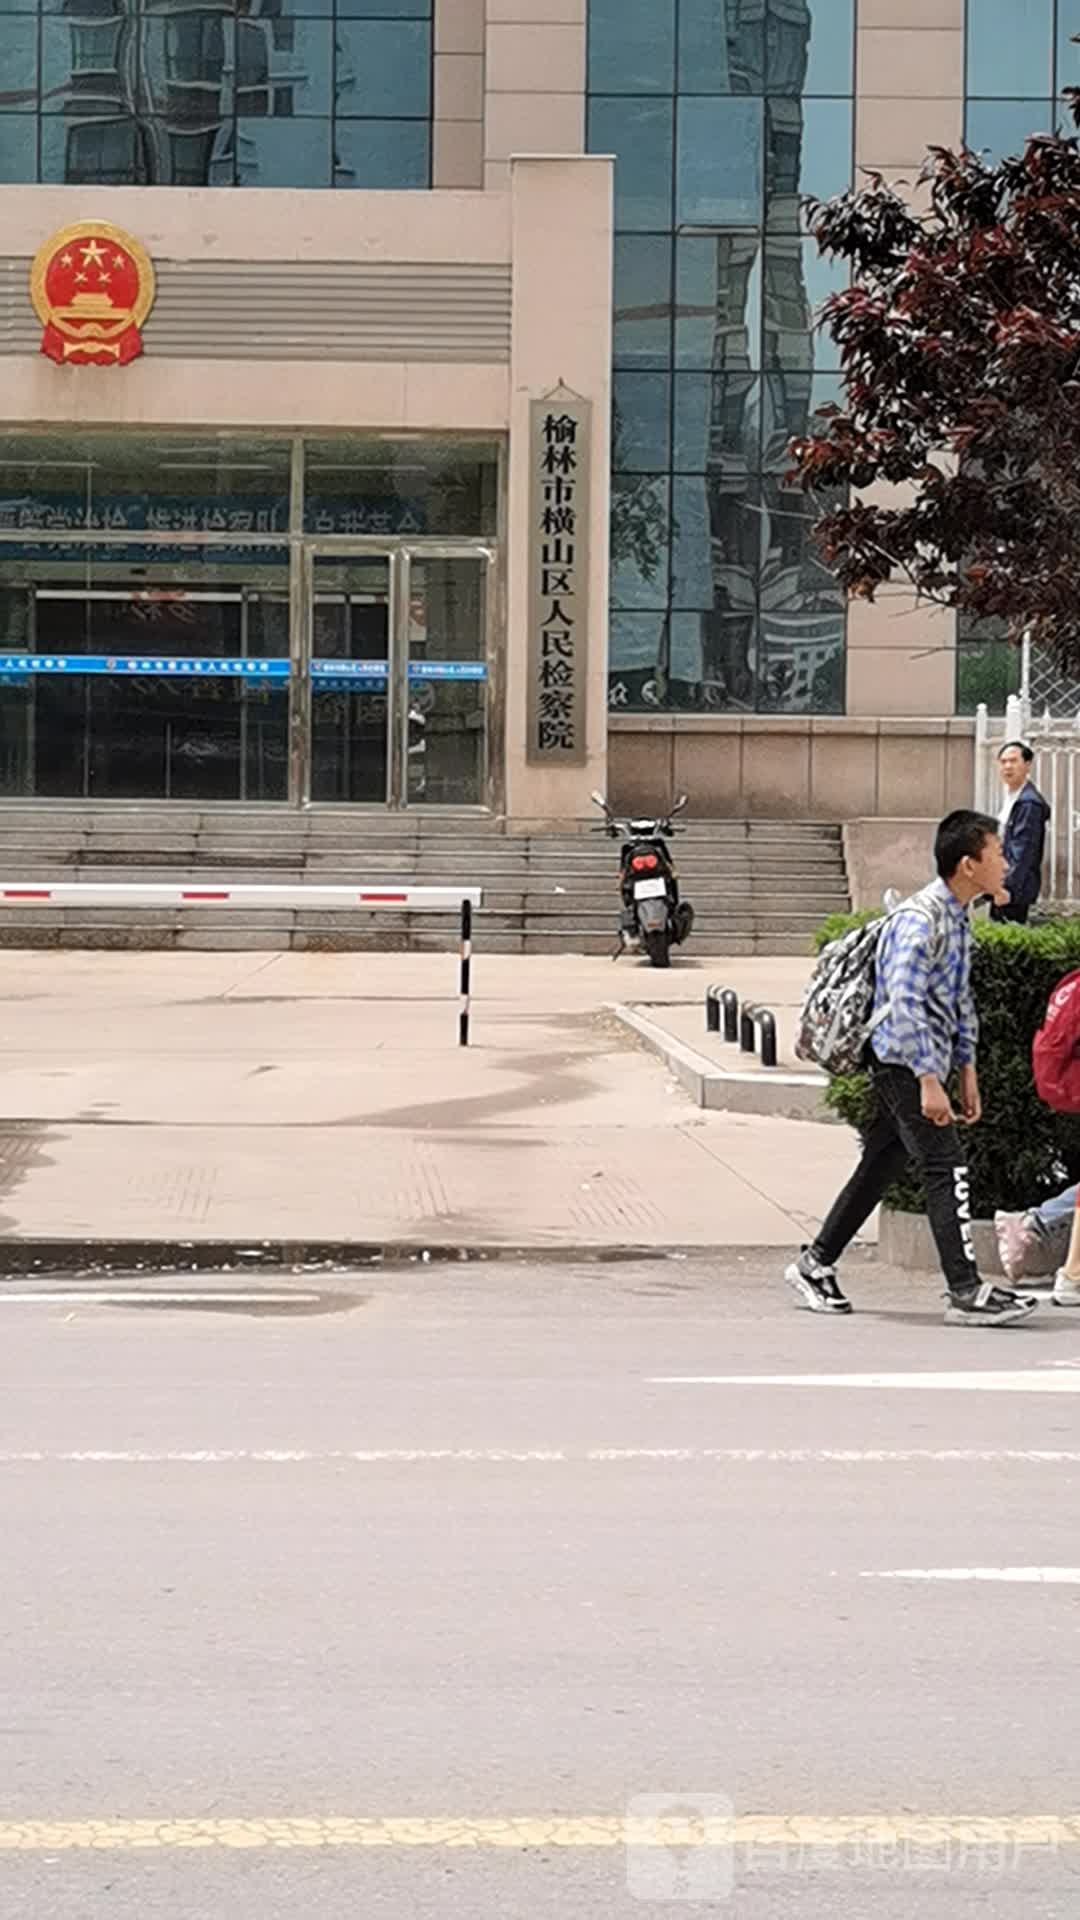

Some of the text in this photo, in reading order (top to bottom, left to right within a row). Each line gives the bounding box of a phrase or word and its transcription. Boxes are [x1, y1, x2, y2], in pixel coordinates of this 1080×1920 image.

[538, 414, 578, 750] 榆林市横山区人民检察院
